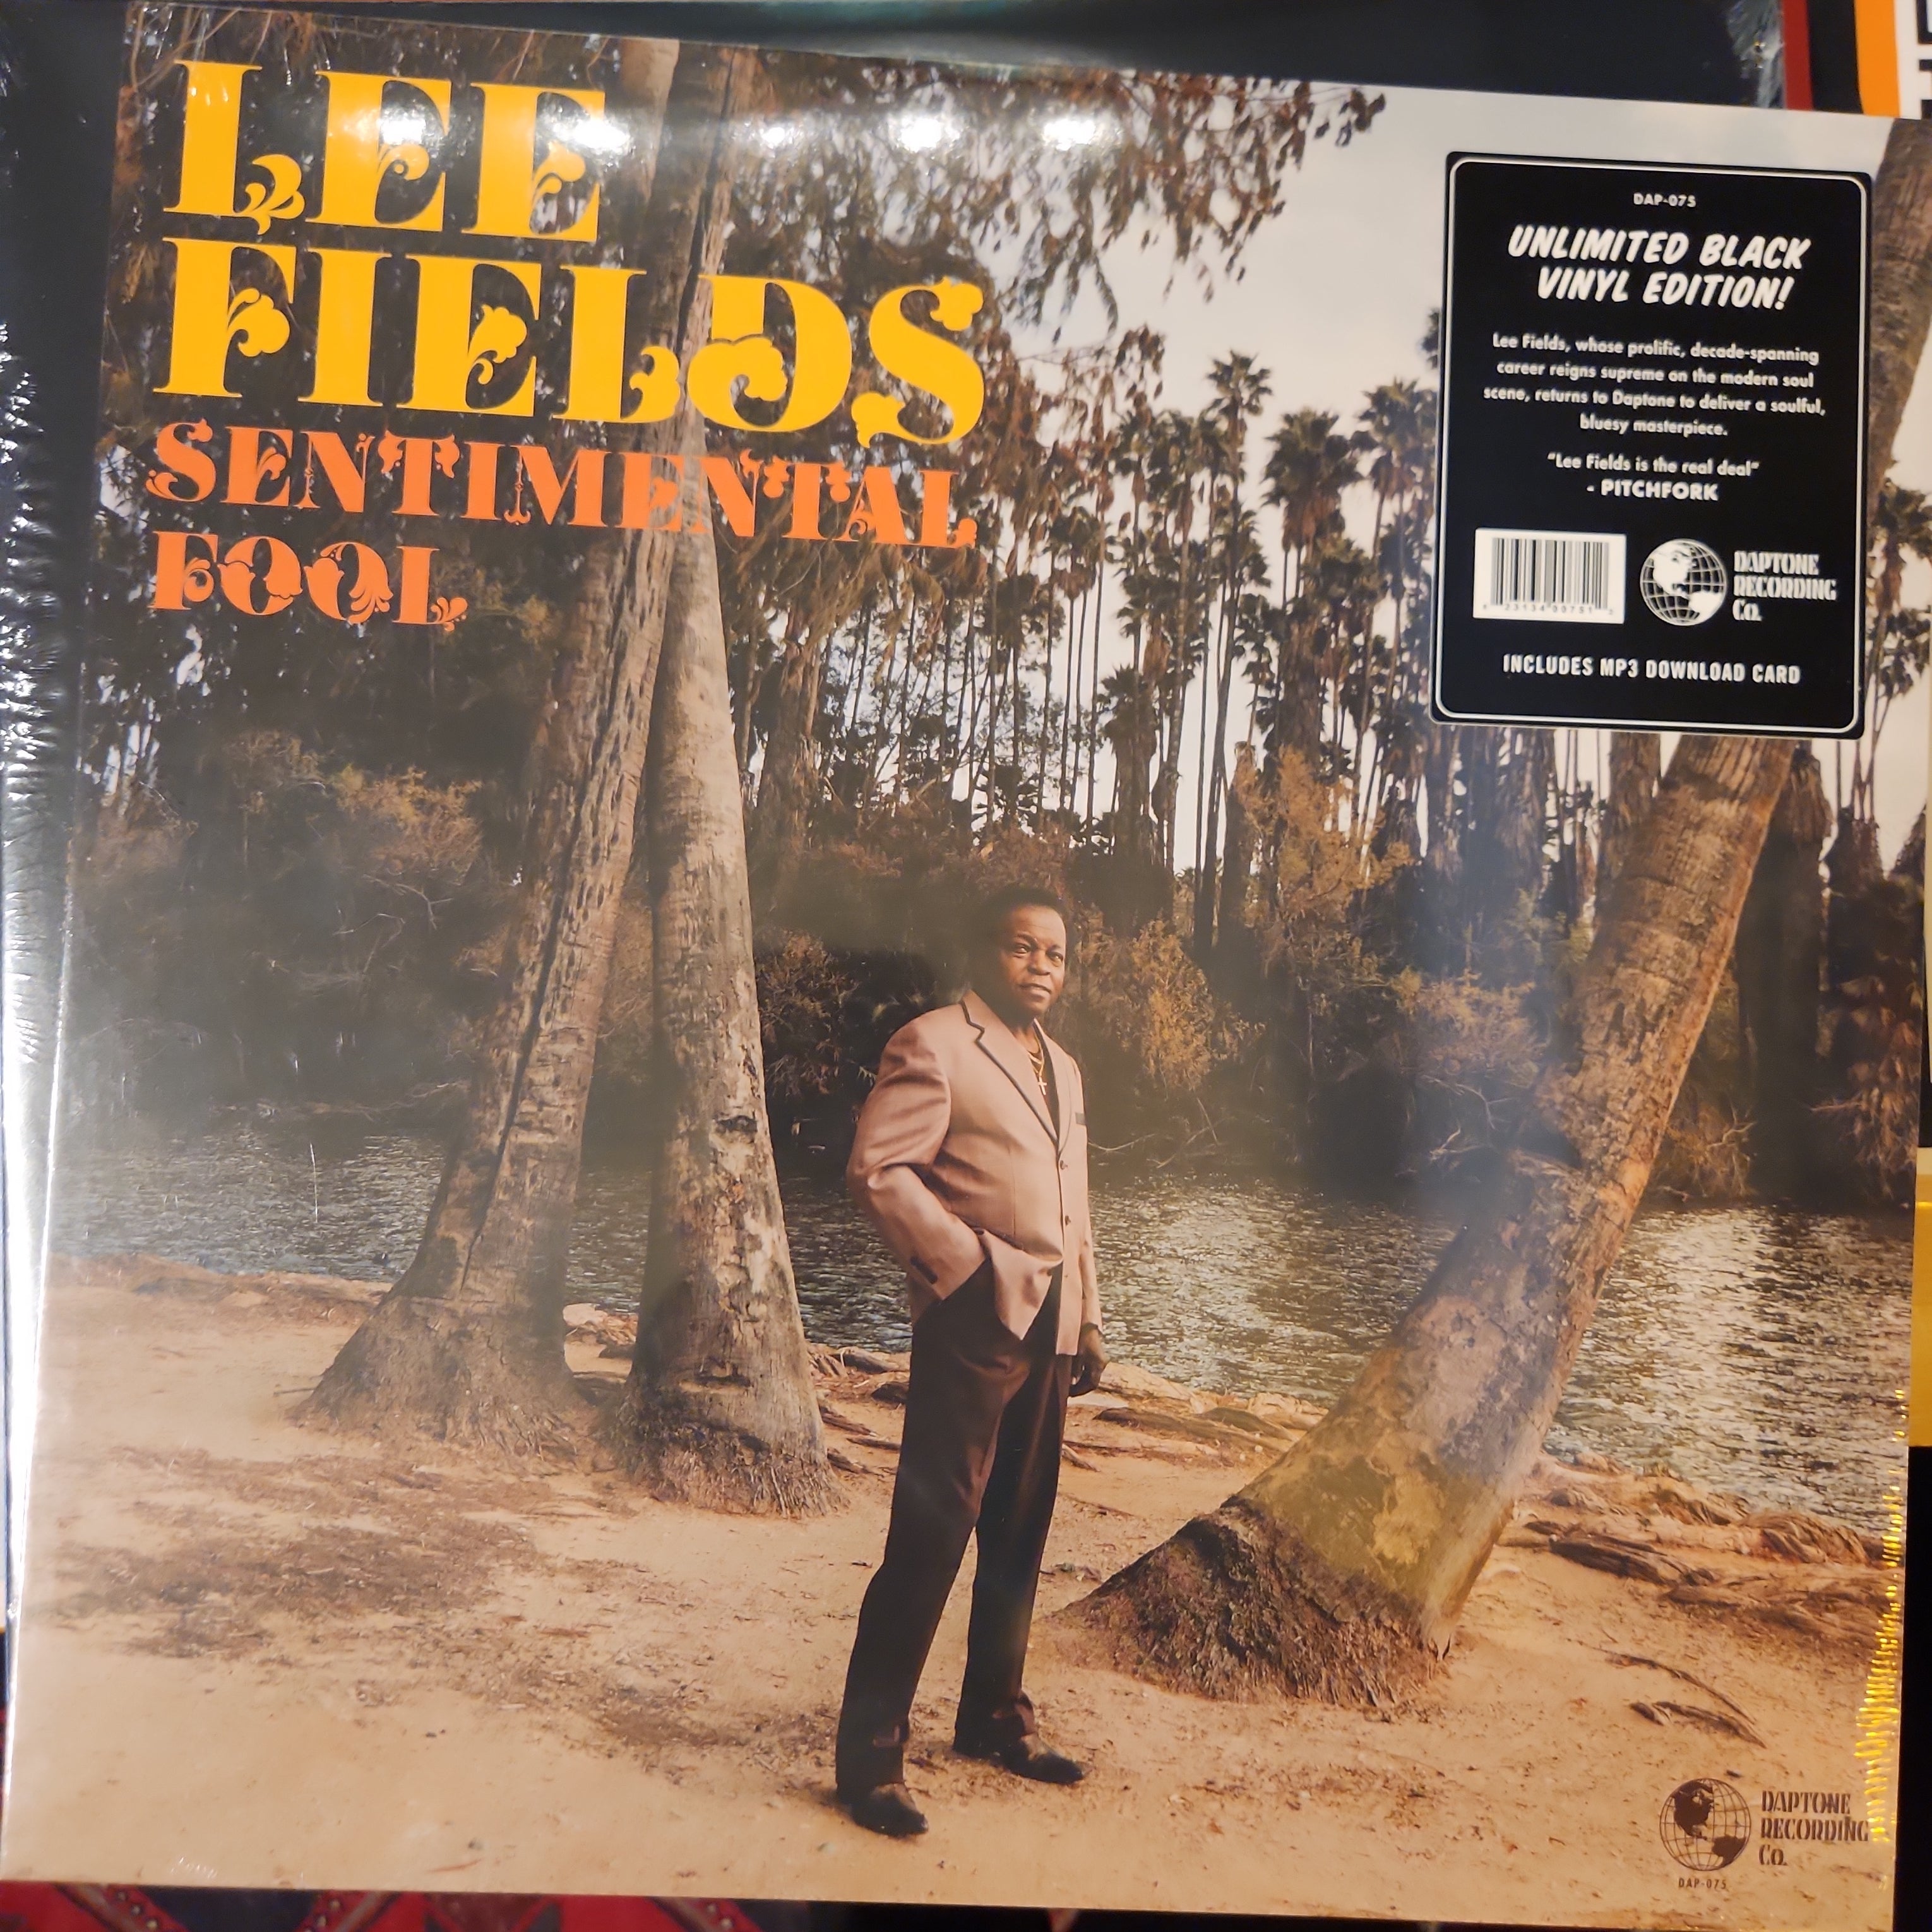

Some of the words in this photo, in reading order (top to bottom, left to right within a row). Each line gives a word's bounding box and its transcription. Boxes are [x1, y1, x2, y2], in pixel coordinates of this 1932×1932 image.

[164, 59, 605, 241] LEE
[1634, 193, 1696, 207] DAP-075
[1508, 225, 1689, 264] UNLIMITED
[1700, 234, 1811, 269] BLACK
[1538, 266, 1629, 302] VINYL
[1643, 271, 1794, 309] EDITION!
[153, 237, 986, 448] FIELDS
[1493, 333, 1518, 348] Lee
[1523, 333, 1570, 352] Fields,
[1575, 337, 1623, 353] whose
[1628, 340, 1685, 357] prolific,
[1691, 342, 1818, 366] decade-spanning
[1497, 362, 1545, 375] career
[1550, 363, 1596, 380] reigns
[1601, 367, 1664, 383] supreme
[1669, 371, 1688, 381] on
[1693, 368, 1716, 383] the
[1720, 370, 1778, 385] modern
[1783, 373, 1813, 387] soul
[1484, 388, 1530, 402] scene,
[1535, 389, 1588, 403] returns
[1593, 391, 1607, 404] to
[1613, 390, 1675, 409] Daptone
[1680, 396, 1695, 408] to
[1699, 394, 1751, 410] deliver
[1755, 401, 1766, 411] a
[1771, 398, 1825, 415] soulful,
[1580, 414, 1629, 434] bluesy
[1633, 420, 1727, 438] masterpiece.
[1587, 454, 1631, 470] Fields
[1636, 457, 1648, 471] is
[1653, 456, 1677, 472] the
[1682, 459, 1712, 474] real
[146, 419, 978, 549] SENTIMENTAL
[1602, 479, 1717, 501] PITCHFORK
[1734, 551, 1818, 575] DAPTONE
[149, 530, 469, 632] FOOL
[1734, 575, 1836, 600] RECORDING
[1503, 654, 1593, 676] INCLUDES
[1601, 659, 1638, 677] MP3
[1646, 660, 1745, 681] DOWNLOAD
[1753, 664, 1800, 684] CARD
[1762, 1791, 1850, 1814] DAPTONE
[1761, 1816, 1868, 1841] RECORDING
[1679, 1878, 1726, 1888] DAP-075
